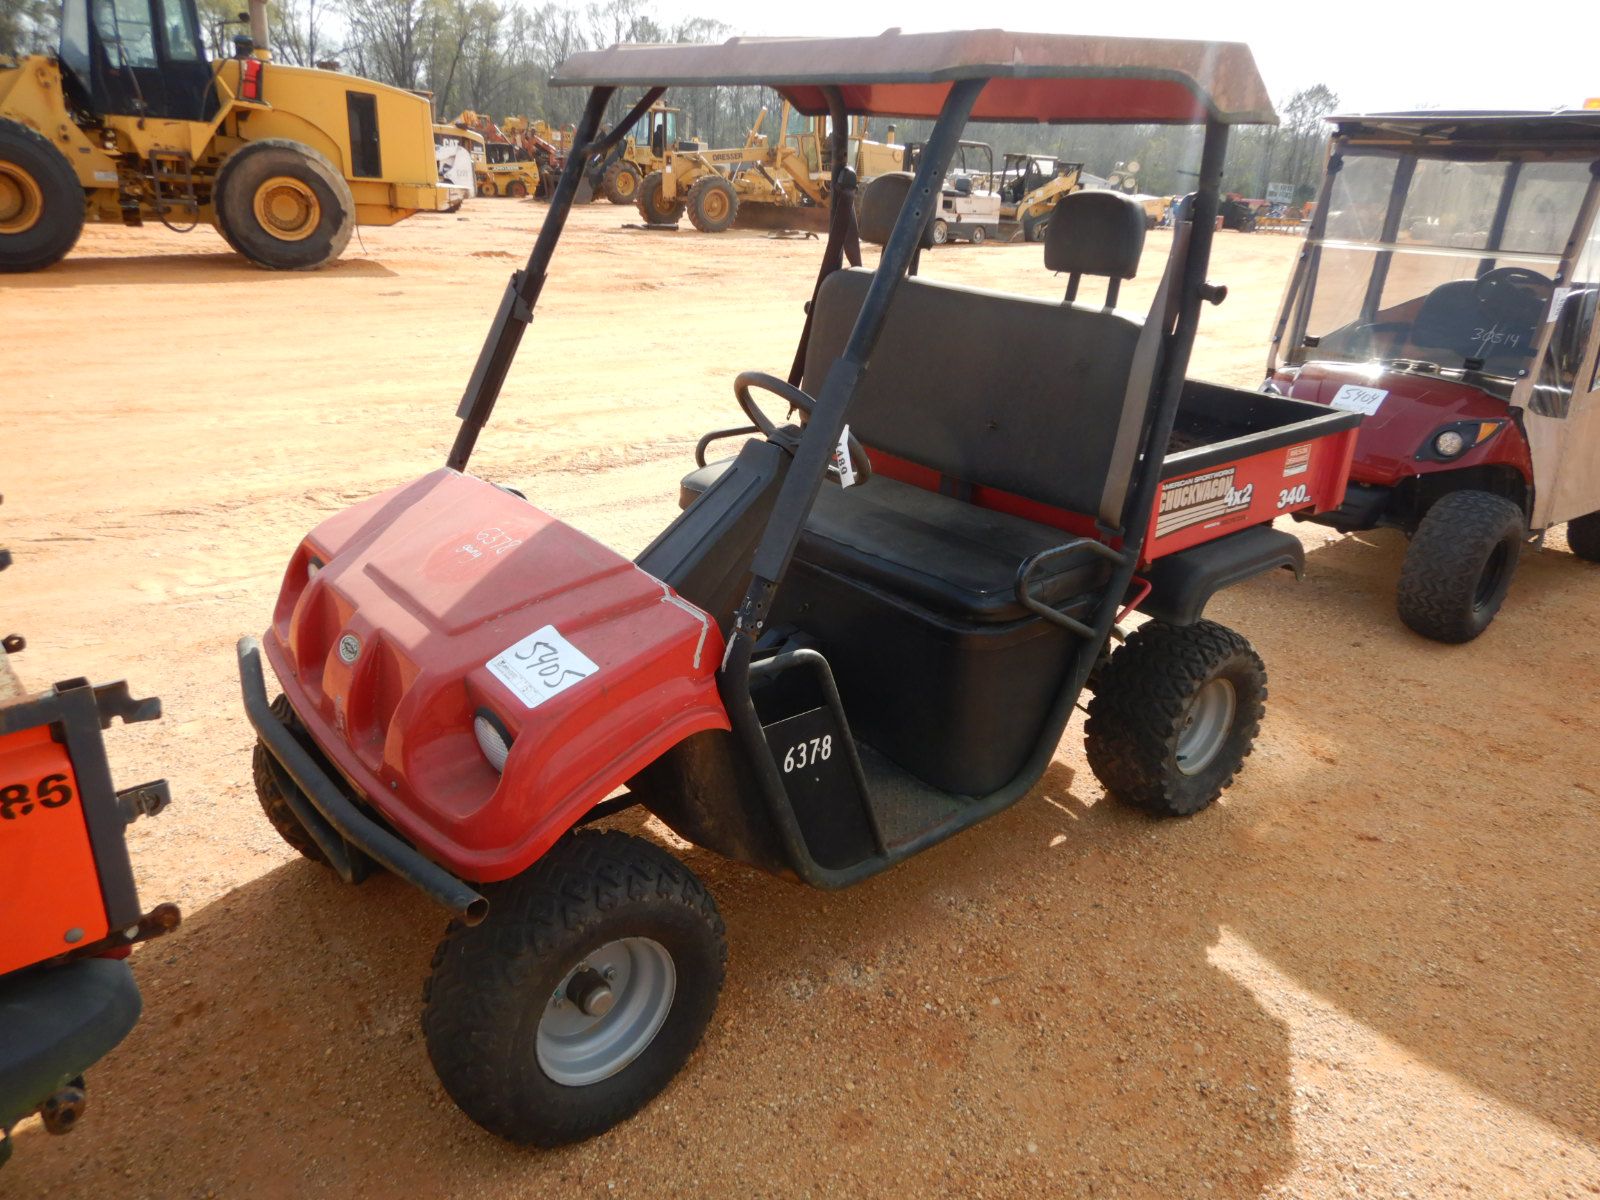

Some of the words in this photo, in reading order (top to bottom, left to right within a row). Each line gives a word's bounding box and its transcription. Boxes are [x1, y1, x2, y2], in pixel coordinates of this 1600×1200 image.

[443, 138, 460, 148] CAT
[1341, 388, 1380, 405] 5404
[1223, 483, 1254, 508] 4x2
[515, 641, 587, 688] 5405
[783, 734, 832, 773] 6378
